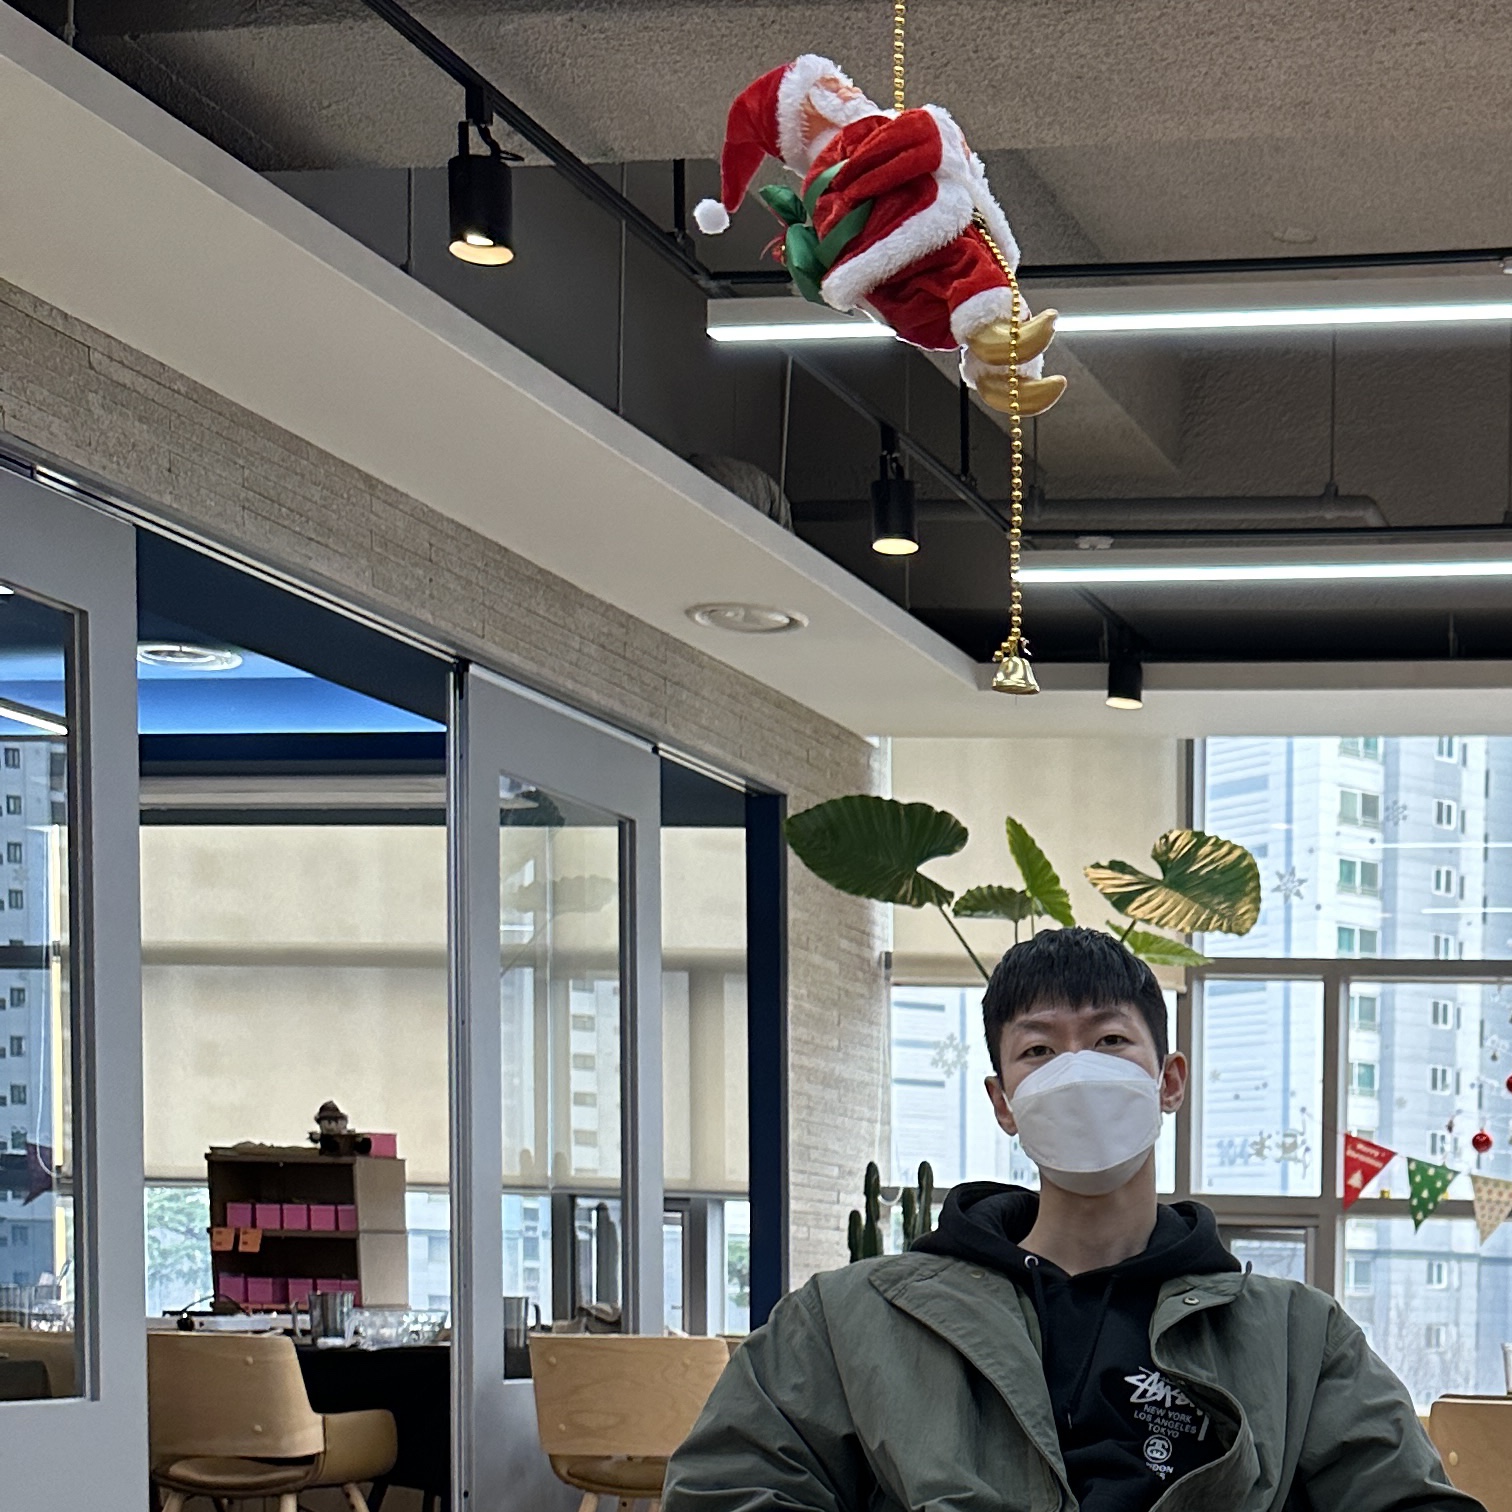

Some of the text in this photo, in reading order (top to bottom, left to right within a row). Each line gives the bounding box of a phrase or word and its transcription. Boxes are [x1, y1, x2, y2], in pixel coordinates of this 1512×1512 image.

[1133, 1410, 1197, 1434] LOS ANGELES
[1143, 1403, 1193, 1423] NEW YORK
[1148, 1422, 1180, 1438] TOKYO
